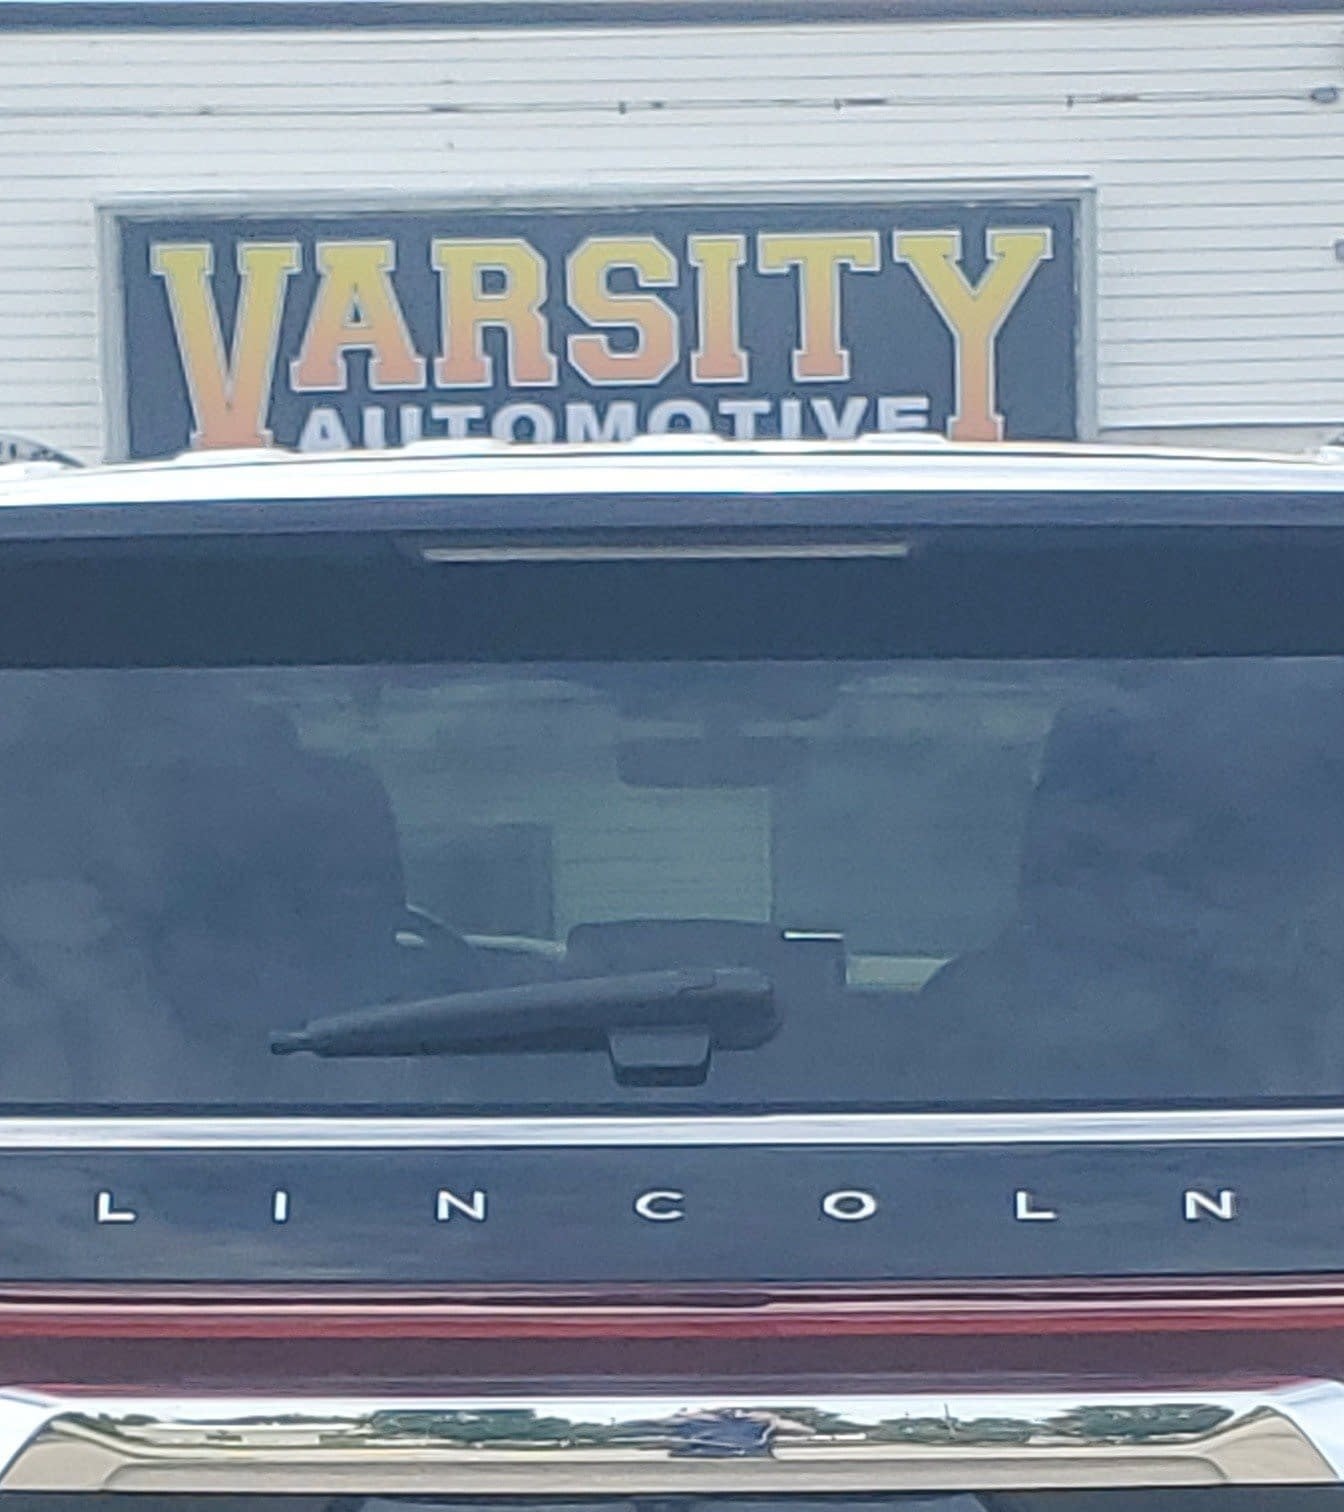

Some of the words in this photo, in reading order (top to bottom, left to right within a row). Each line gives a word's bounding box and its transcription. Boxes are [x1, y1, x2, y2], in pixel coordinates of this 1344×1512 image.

[149, 228, 1054, 450] VARSITY
[298, 397, 930, 450] AUTOMOTIVE
[96, 1190, 1234, 1223] LINCOLN
